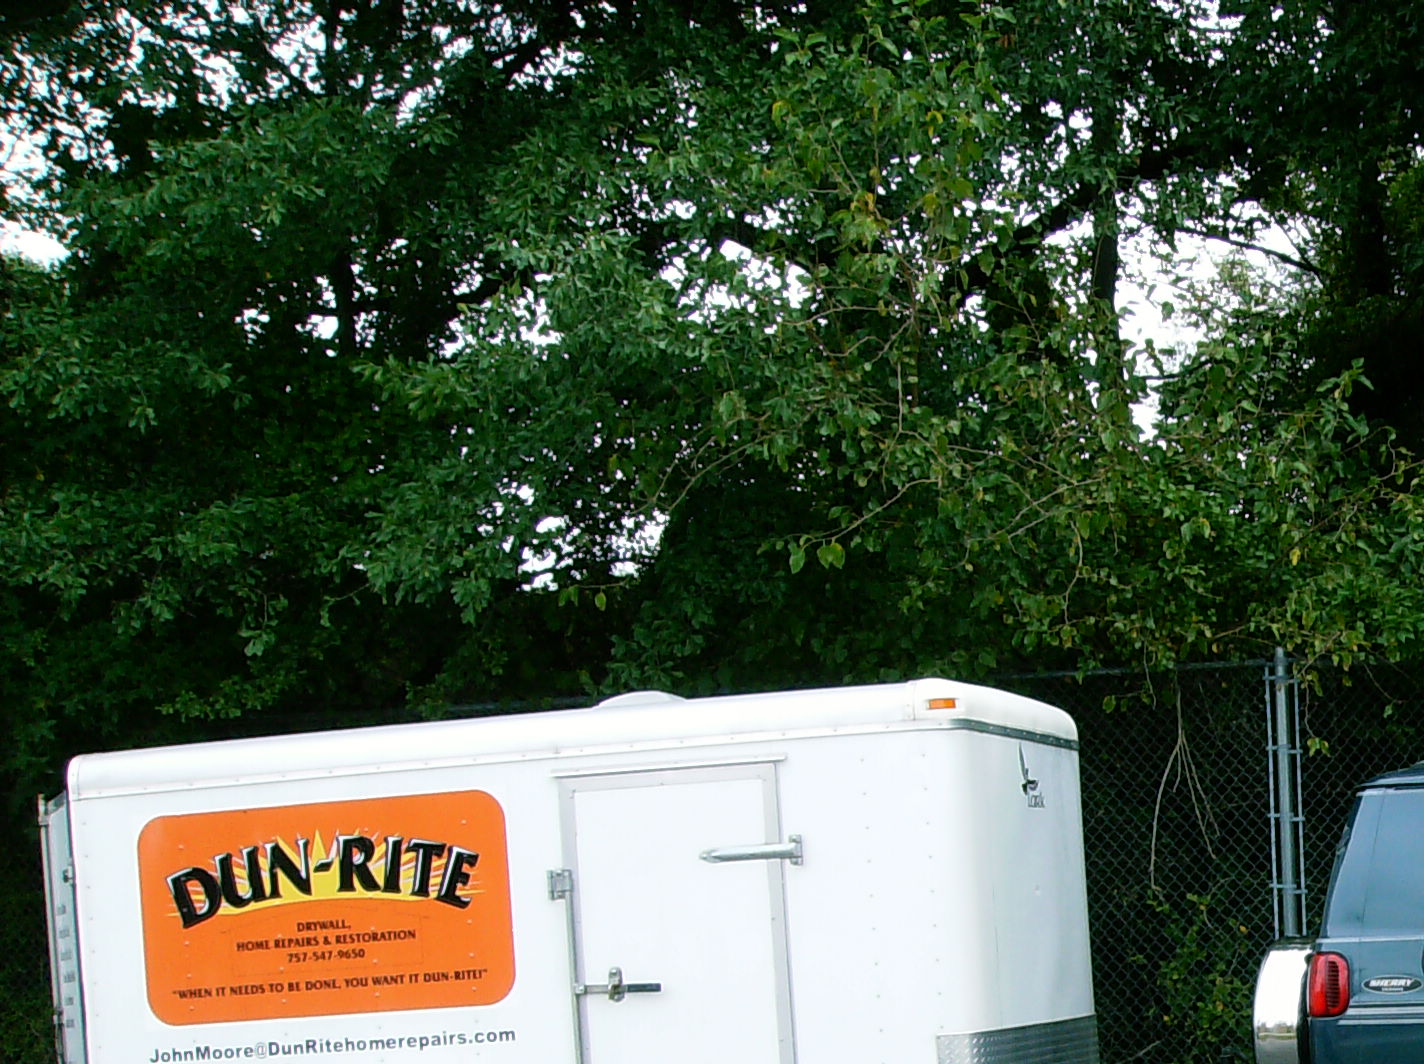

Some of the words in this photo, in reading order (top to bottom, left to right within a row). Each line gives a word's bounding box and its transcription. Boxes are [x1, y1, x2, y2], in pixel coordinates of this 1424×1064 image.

[166, 834, 480, 929] DUN-RITE
[296, 919, 351, 933] DRYWALL,
[236, 940, 270, 951] HOME
[274, 937, 320, 949] REPAIRS
[323, 935, 332, 946] &
[335, 929, 416, 945] RESTORATION
[287, 948, 365, 963] 757-547-9650
[172, 987, 212, 999] "WHEN
[216, 986, 226, 997] IT
[230, 983, 265, 996] NEEDS
[269, 983, 284, 993] TO
[288, 981, 300, 992] BE
[344, 977, 368, 988] YOU
[371, 974, 406, 986] WANT
[409, 973, 419, 984] IT
[149, 1028, 516, 1064] JohnMoore@DunRitehomerepairs.com
